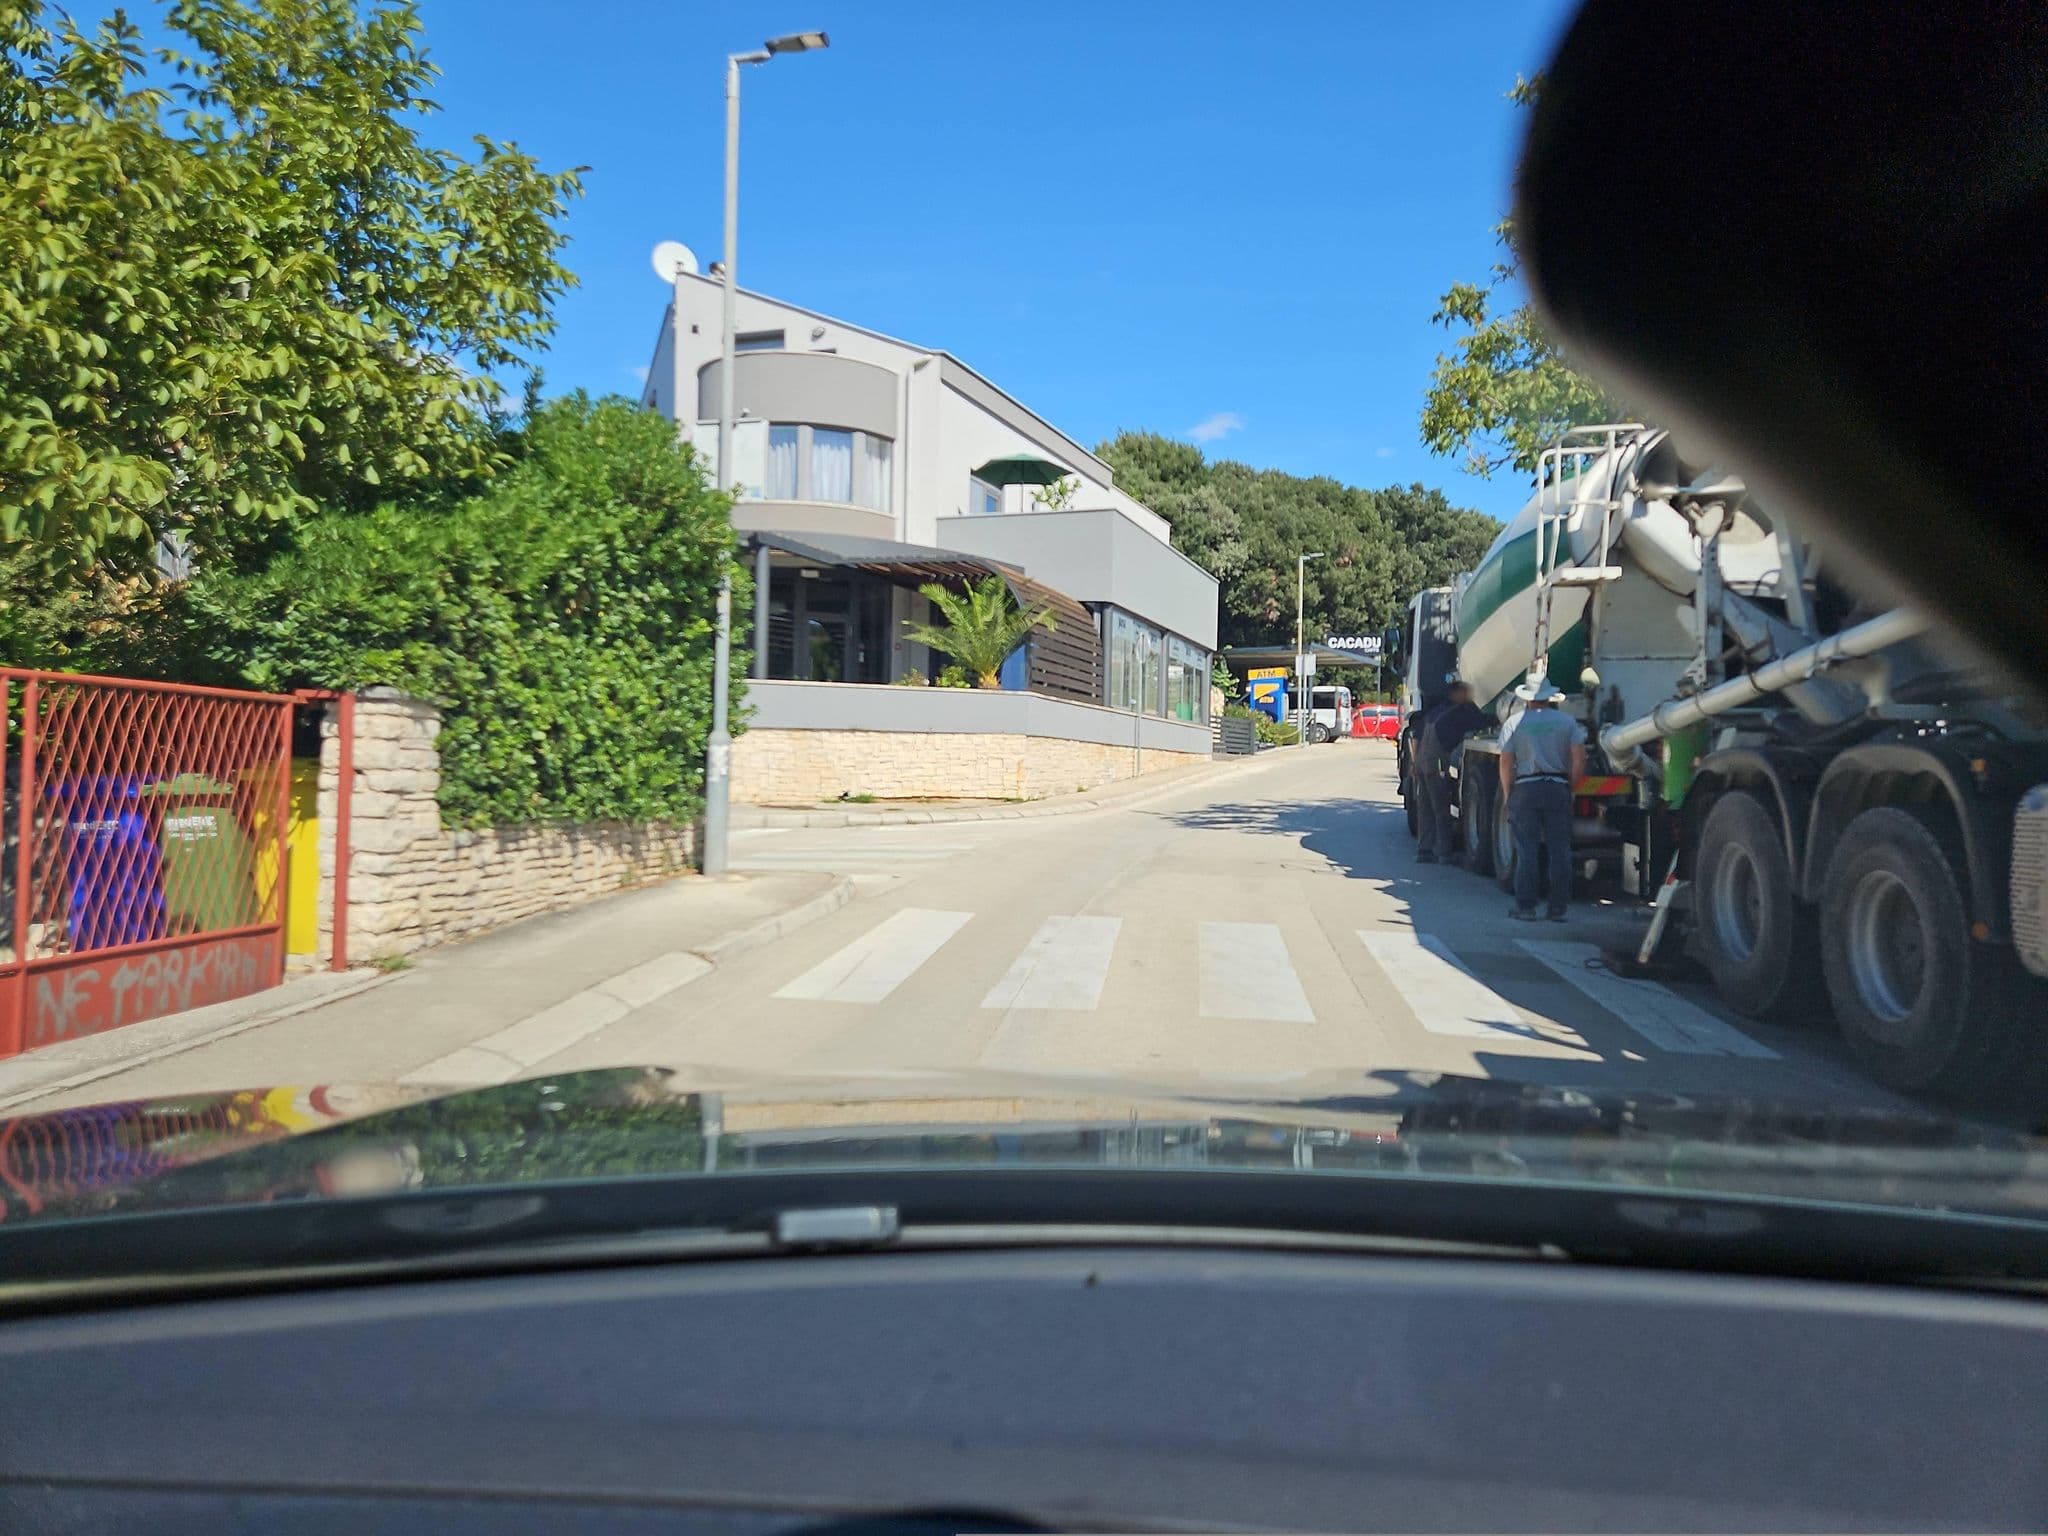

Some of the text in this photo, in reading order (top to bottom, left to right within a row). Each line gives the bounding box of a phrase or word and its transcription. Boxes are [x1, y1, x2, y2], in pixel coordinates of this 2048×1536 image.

[1328, 637, 1381, 649] CACADU
[1257, 670, 1276, 678] ATM
[36, 968, 99, 1040] NE
